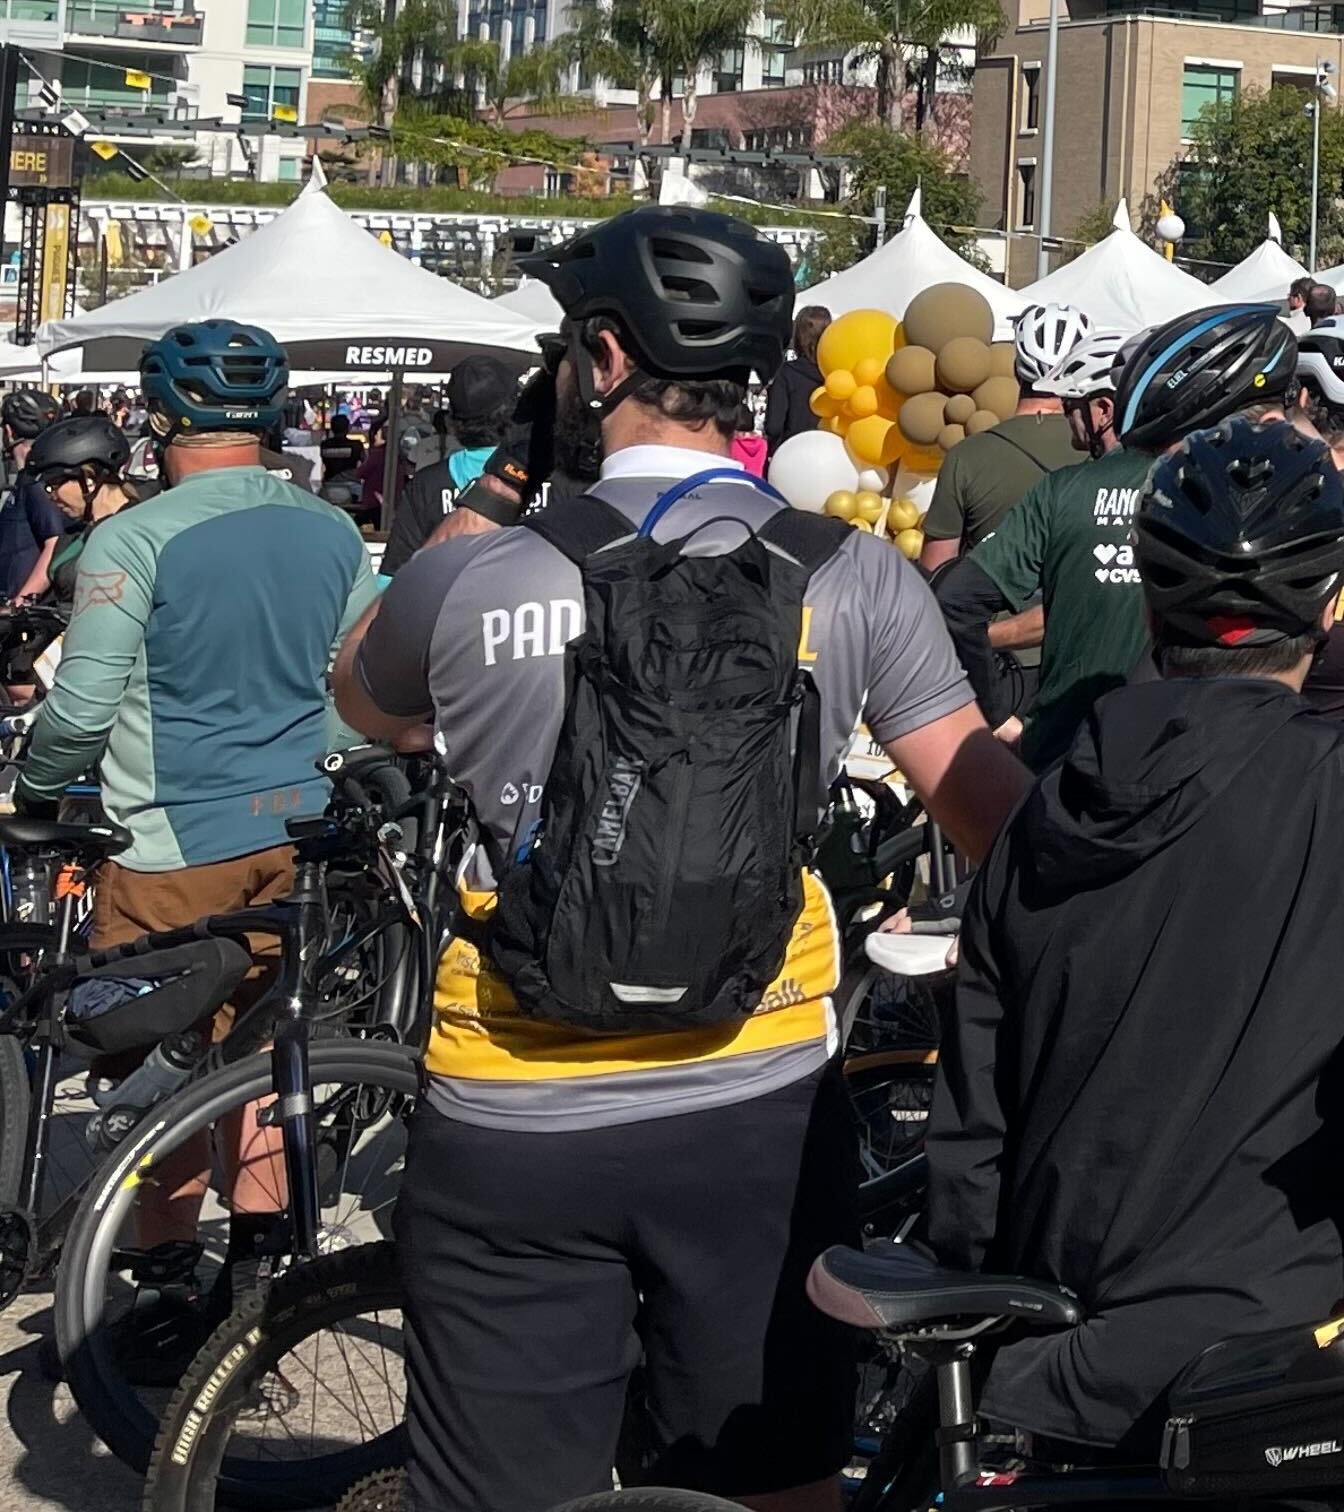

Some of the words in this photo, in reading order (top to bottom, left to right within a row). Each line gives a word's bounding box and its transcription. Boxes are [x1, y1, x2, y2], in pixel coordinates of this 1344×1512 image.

[345, 346, 433, 366] RESMED
[482, 599, 585, 666] PAD
[591, 756, 644, 866] CAMELBAK
[170, 1408, 201, 1466] HIGH
[194, 1342, 248, 1413] ROLLER
[1283, 1440, 1341, 1461] WHEEL
